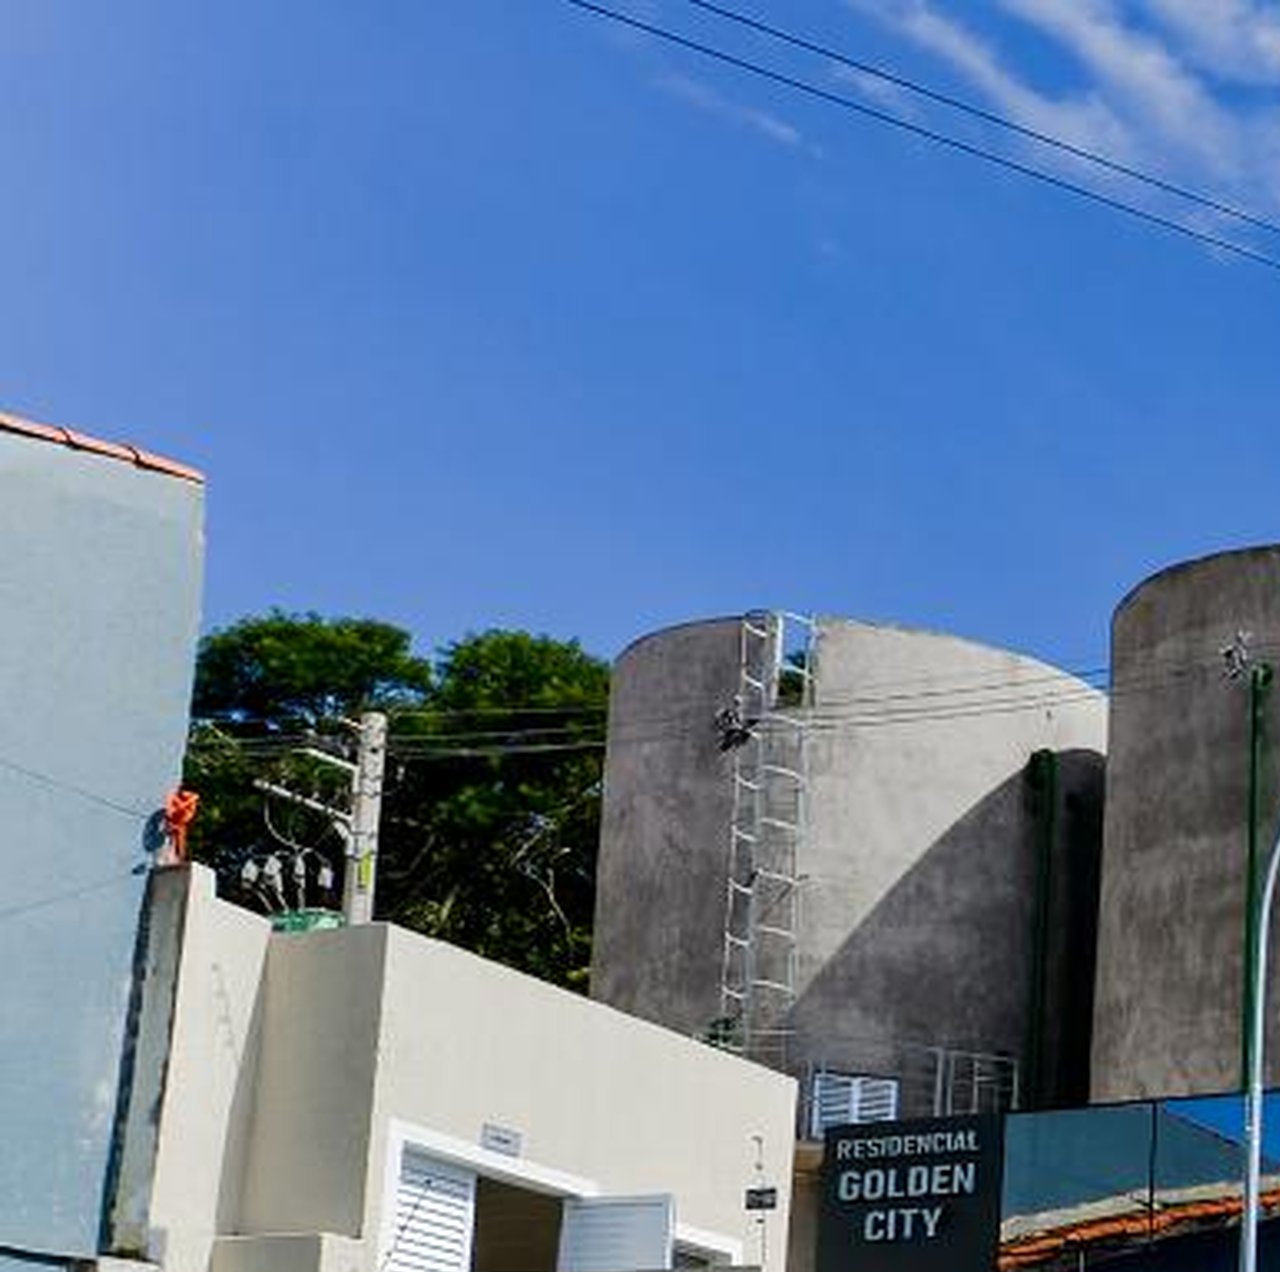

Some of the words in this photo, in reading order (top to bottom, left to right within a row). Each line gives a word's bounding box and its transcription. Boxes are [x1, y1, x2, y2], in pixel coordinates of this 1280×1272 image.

[837, 1130, 980, 1160] RESIDENCIAL
[840, 1164, 976, 1200] GOLDEN
[864, 1207, 942, 1241] CITY
